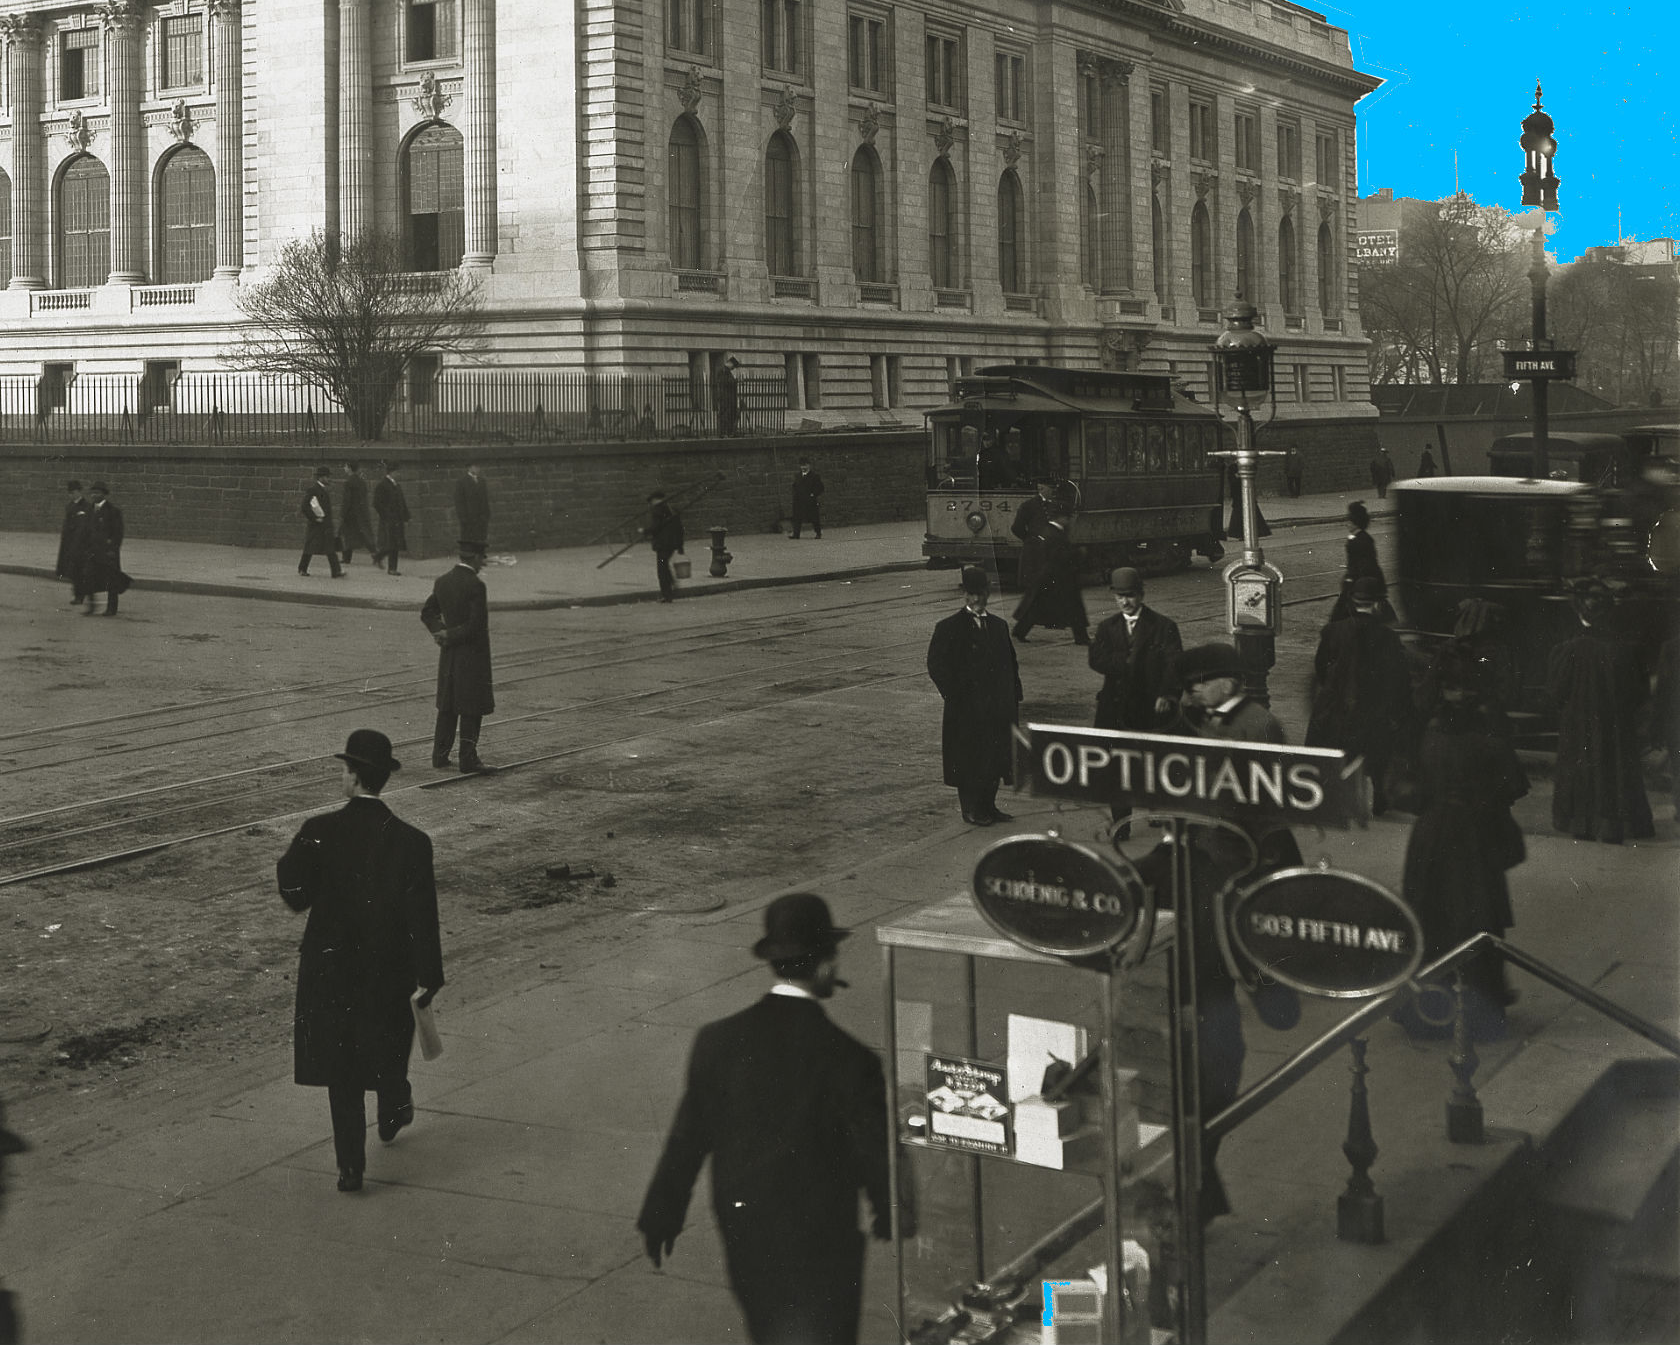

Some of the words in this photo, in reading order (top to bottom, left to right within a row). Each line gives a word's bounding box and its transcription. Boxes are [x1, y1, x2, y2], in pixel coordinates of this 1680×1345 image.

[1358, 235, 1394, 245] OTEL
[1356, 246, 1396, 258] LBANY
[1515, 361, 1538, 371] FIFTH
[946, 500, 1012, 512] 2794
[1042, 742, 1324, 811] OPTICIANS
[1072, 888, 1088, 911] &
[1251, 911, 1294, 938] 503
[1298, 918, 1361, 949] FIFTH
